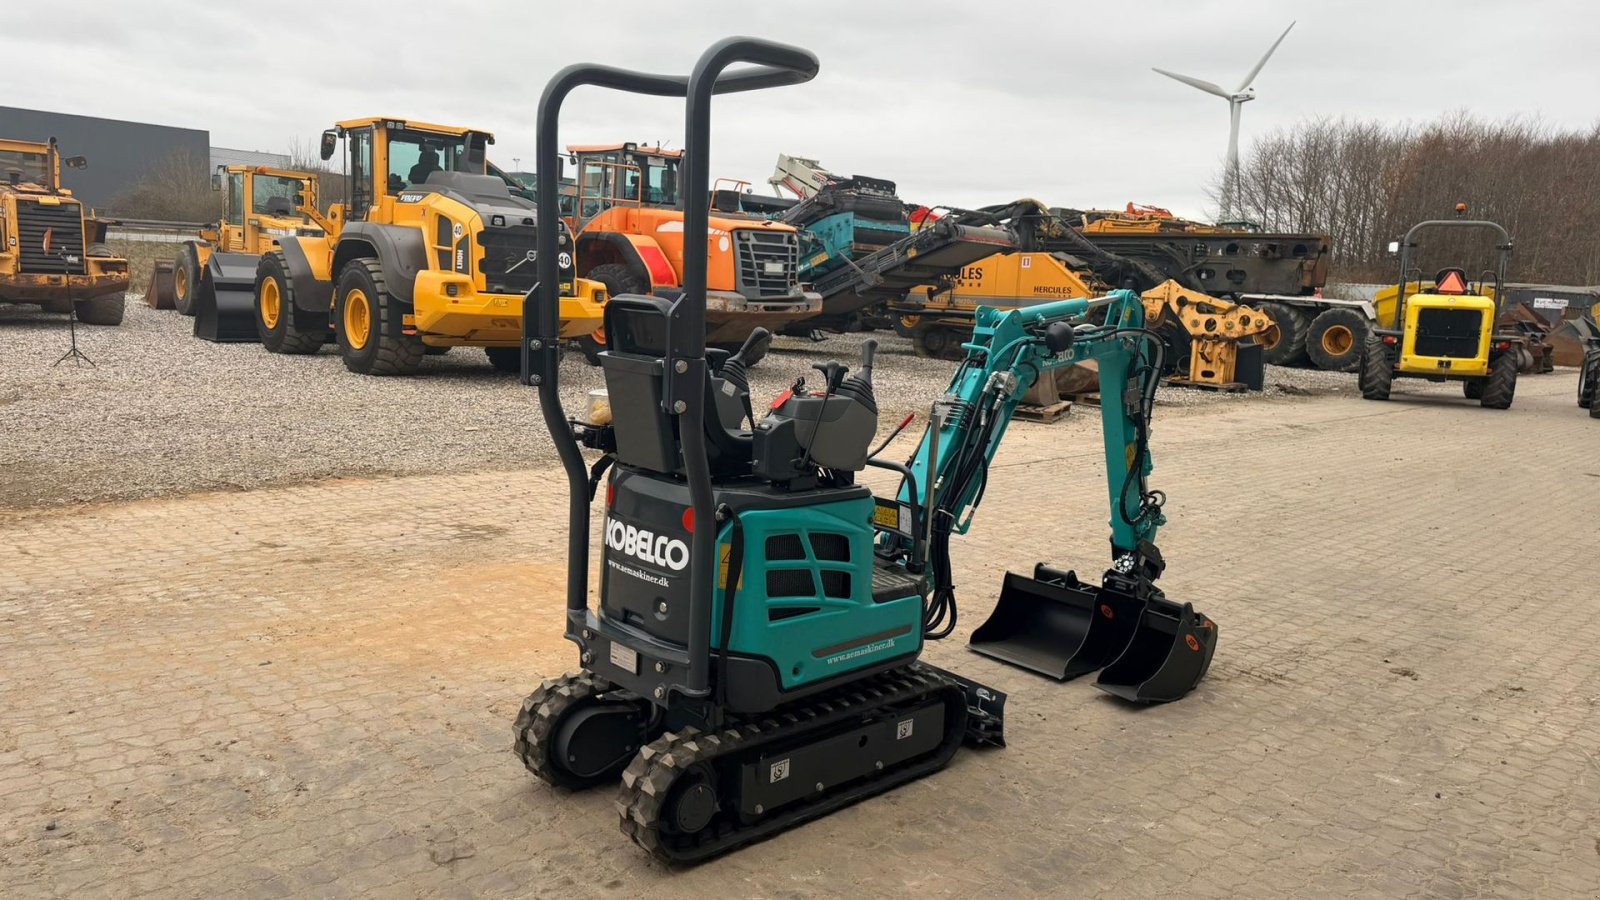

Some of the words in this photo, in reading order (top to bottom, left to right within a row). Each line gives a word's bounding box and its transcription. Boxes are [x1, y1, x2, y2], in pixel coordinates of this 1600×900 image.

[1033, 285, 1072, 295] HERCULES
[605, 516, 689, 571] KOBELCO
[608, 559, 669, 588] www.aemaskiner.dk
[827, 639, 895, 665] www.aemaskiner.dk
